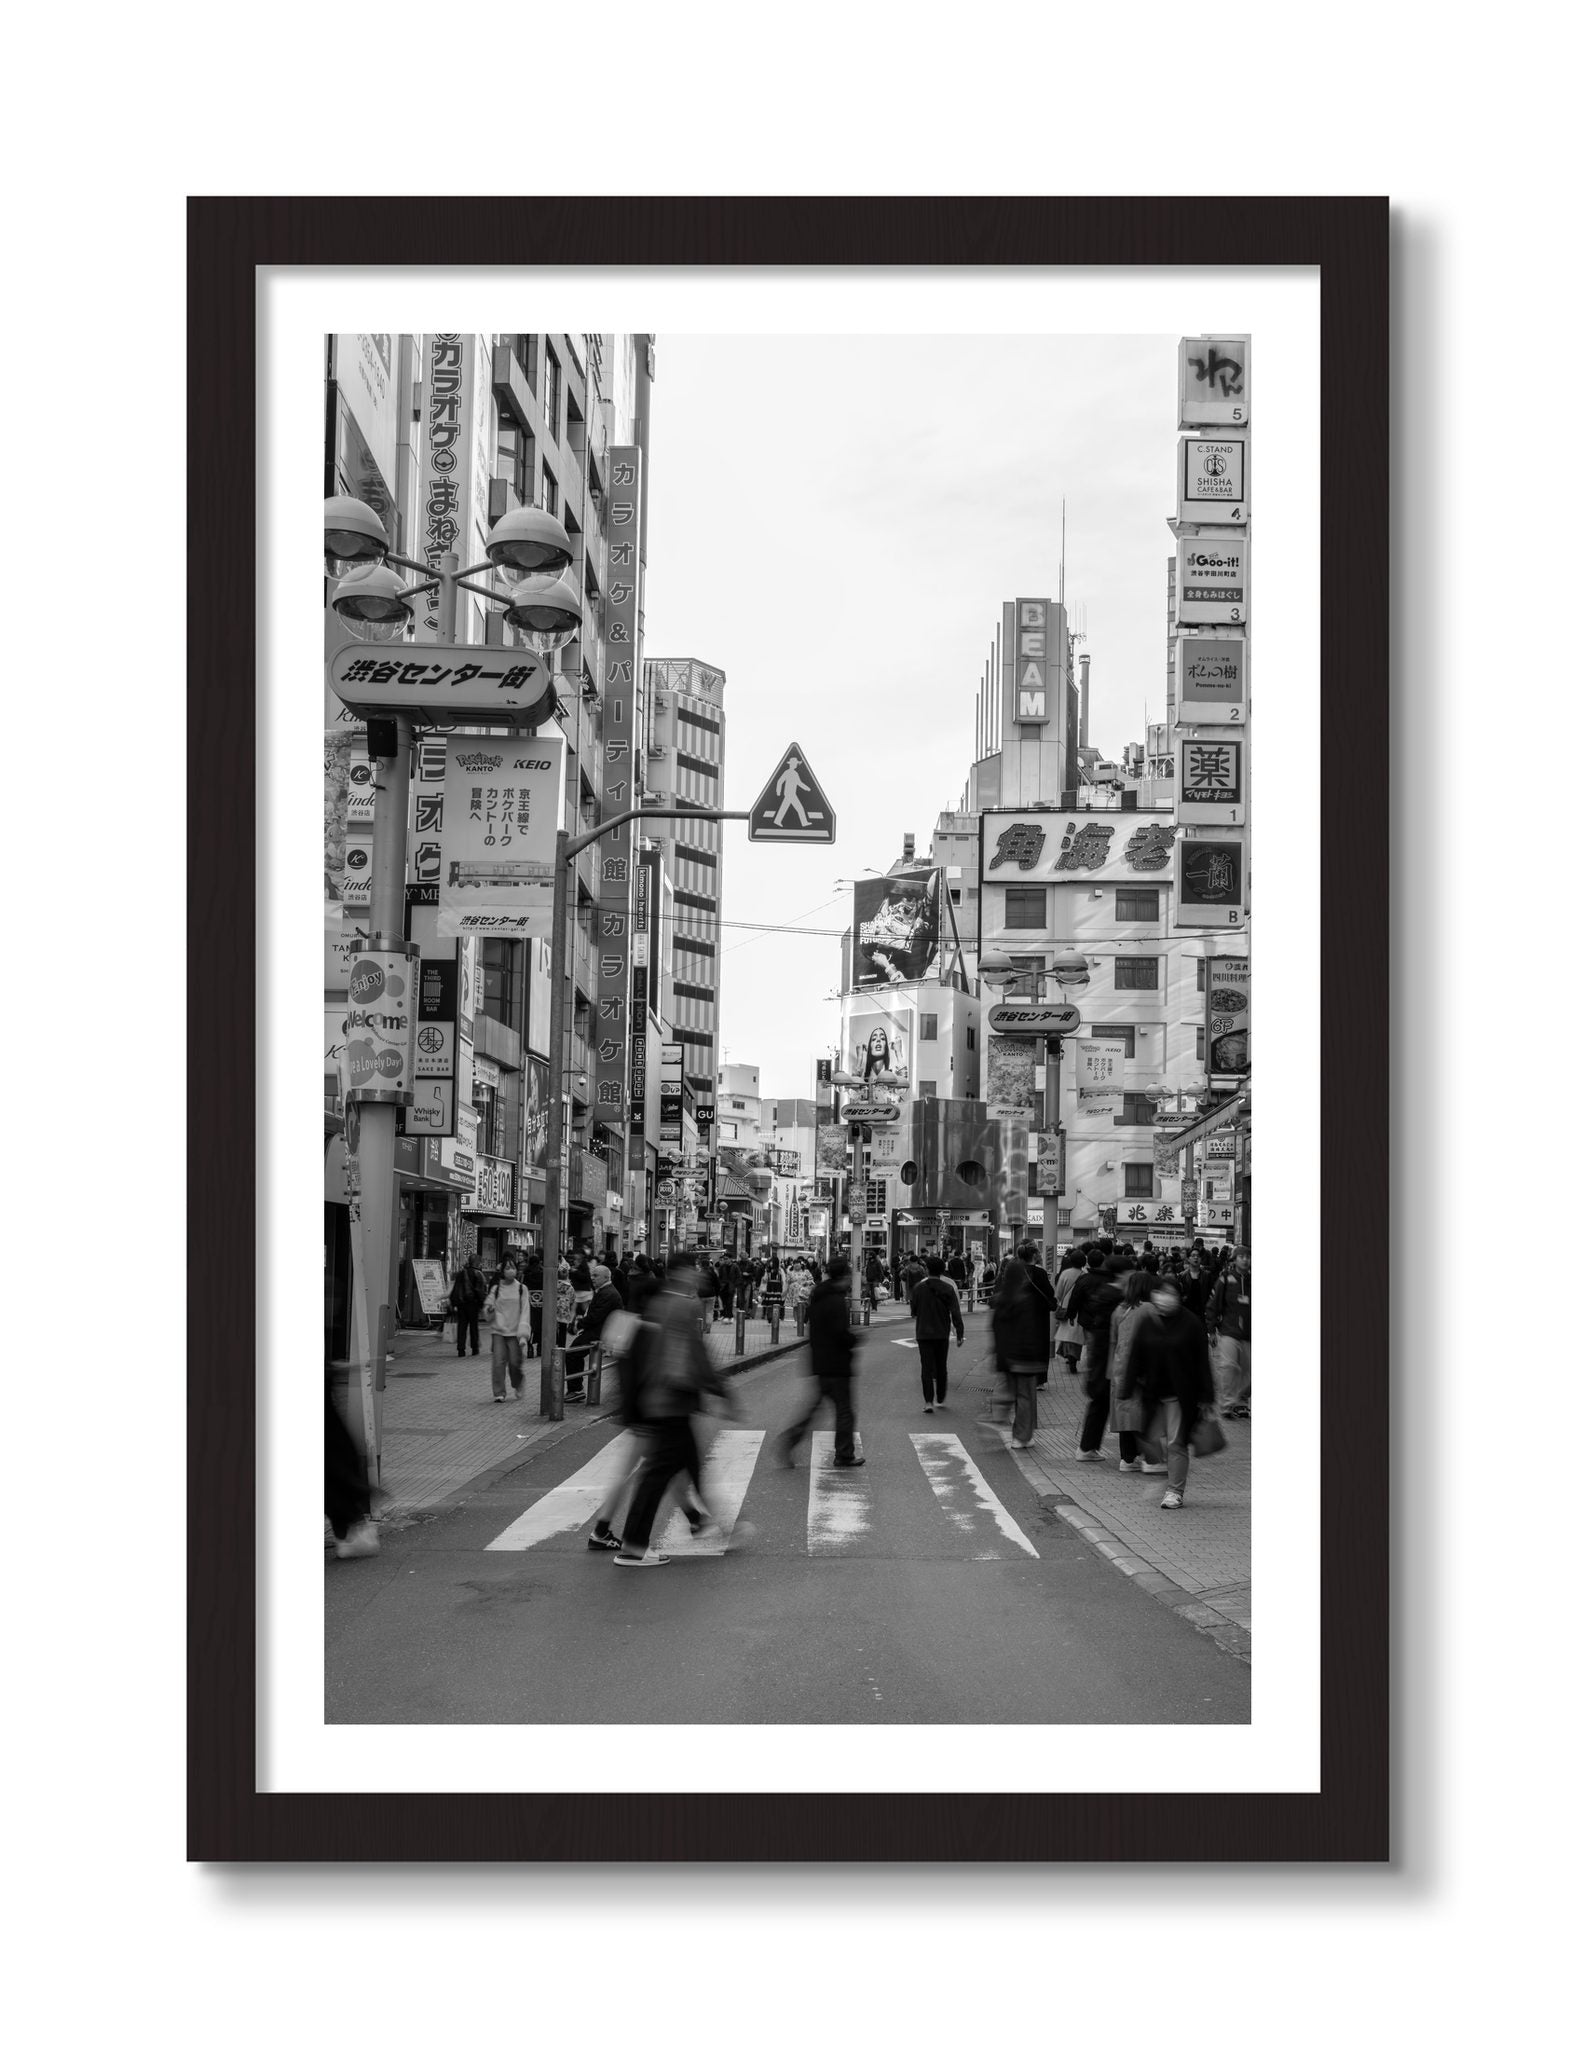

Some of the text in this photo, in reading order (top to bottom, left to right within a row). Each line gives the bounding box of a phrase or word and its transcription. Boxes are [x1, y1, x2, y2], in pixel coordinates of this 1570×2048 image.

[430, 342, 463, 449] カラオケ
[1232, 408, 1242, 420] 5
[1197, 478, 1232, 486] SHISHA
[1231, 608, 1240, 621] 3
[1020, 602, 1046, 716] BEAM
[340, 659, 537, 689] 渋谷センター街
[1230, 708, 1239, 720] 2
[513, 759, 552, 770] KEIO
[1190, 746, 1230, 787] 薬
[484, 787, 498, 846] カントーの
[1229, 809, 1236, 821] 1
[989, 822, 1175, 871] 角海老
[638, 869, 646, 897] kimono
[459, 915, 529, 926] 渋谷センター街
[1229, 910, 1238, 923] B
[351, 969, 383, 998] Enjoy
[994, 1011, 1075, 1022] 渋谷センター街
[414, 1107, 440, 1116] Whisky
[698, 1110, 714, 1119] GU
